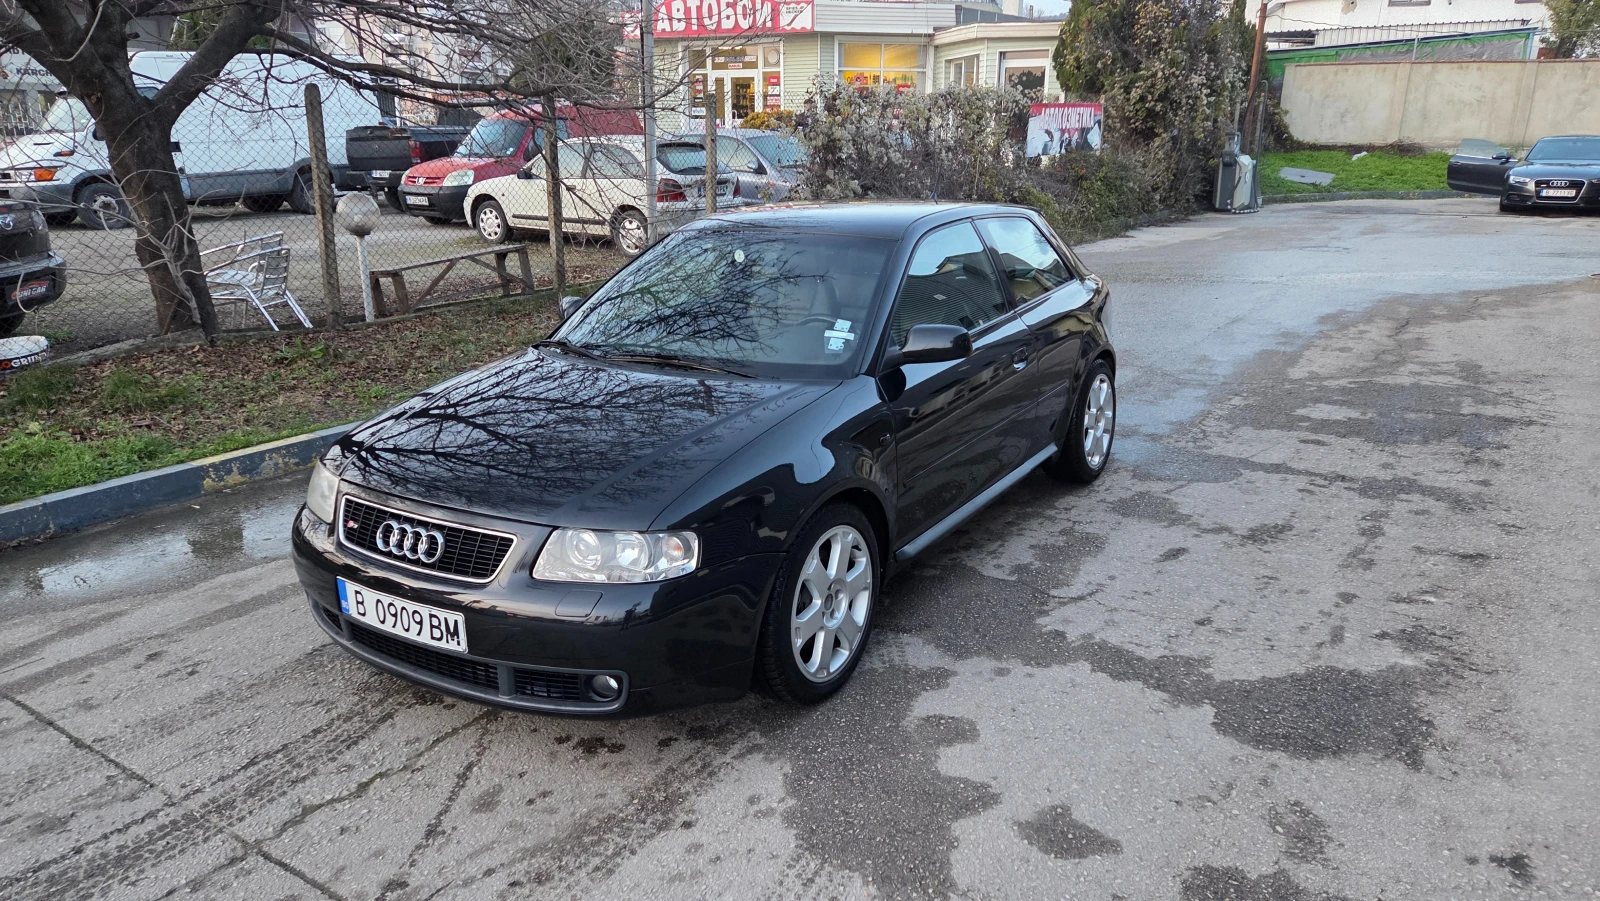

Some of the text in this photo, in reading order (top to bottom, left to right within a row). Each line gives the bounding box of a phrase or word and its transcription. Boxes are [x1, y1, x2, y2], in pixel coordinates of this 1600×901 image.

[656, 0, 772, 32] АВТОБОИ
[1040, 106, 1095, 129] АВТОКОЗМЕТИКА
[354, 589, 367, 618] B
[375, 598, 424, 637] 0909
[428, 612, 461, 647] BM
